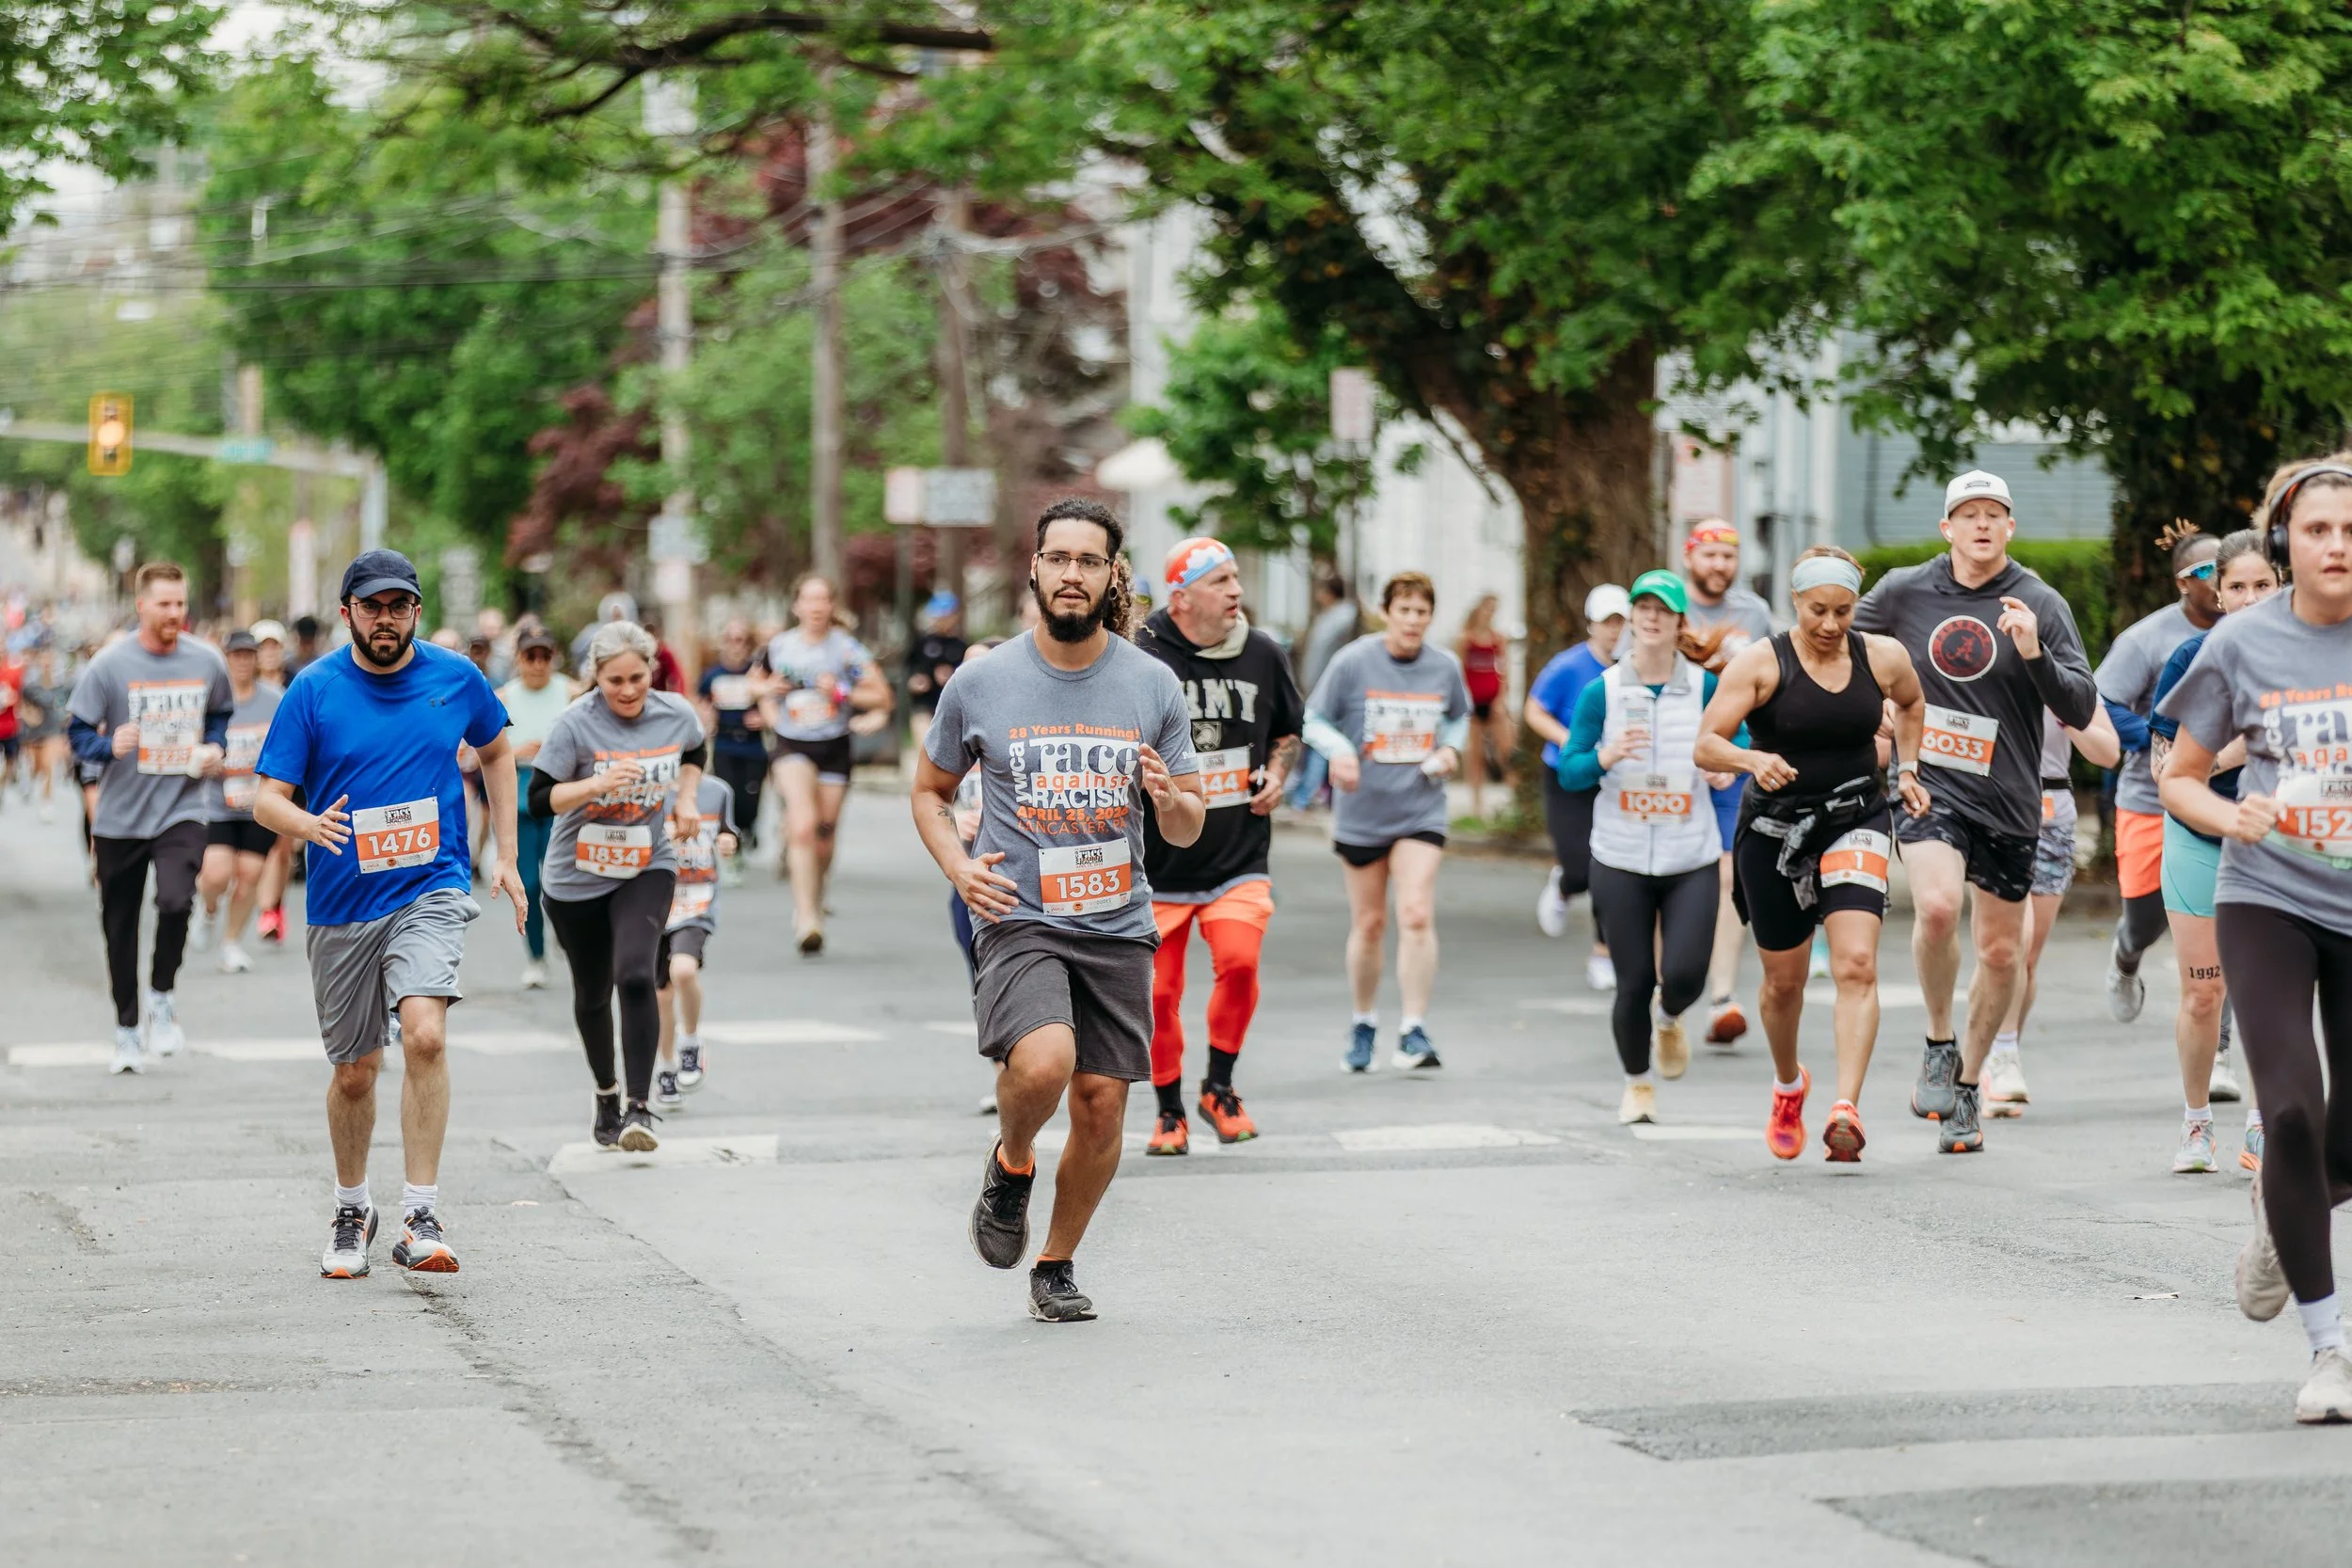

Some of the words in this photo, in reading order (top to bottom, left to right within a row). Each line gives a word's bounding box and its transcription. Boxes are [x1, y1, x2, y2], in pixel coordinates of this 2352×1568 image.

[1182, 678, 1259, 723] RMY
[1009, 727, 1027, 739] 28
[1031, 724, 1071, 736] Years
[1075, 722, 1140, 741] Running!
[1922, 730, 1984, 760] 6033
[1030, 741, 1138, 775] race
[1009, 741, 1032, 803] ywca
[1037, 771, 1129, 793] against
[1032, 788, 1129, 808] RACISM
[1016, 805, 1062, 821] APRIL
[1066, 808, 1090, 822] 25,
[1018, 819, 1109, 835] LANCASTER,
[1113, 819, 1127, 828] PA
[369, 828, 431, 855] 1476
[587, 844, 639, 865] 1834
[1854, 851, 1863, 869] 1
[1057, 869, 1120, 899] 1583
[2190, 965, 2220, 979] 1992
